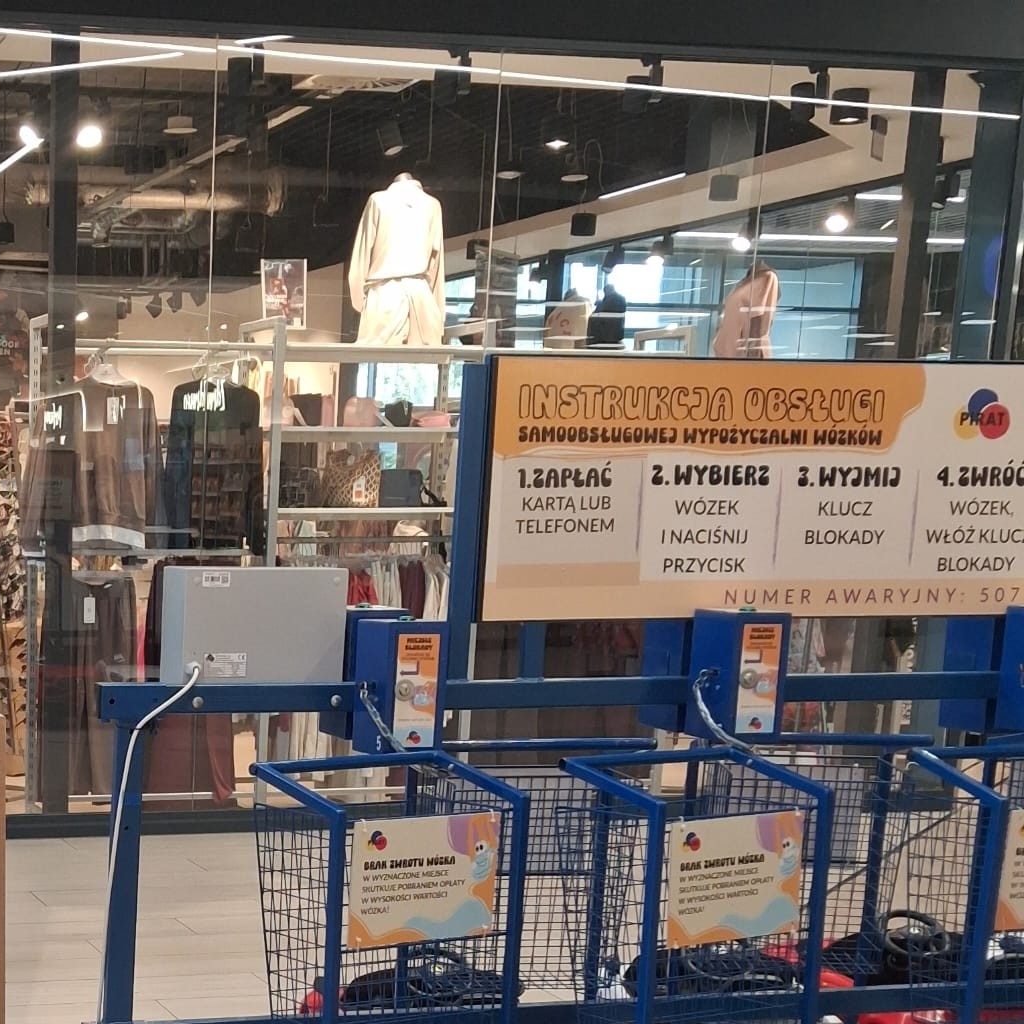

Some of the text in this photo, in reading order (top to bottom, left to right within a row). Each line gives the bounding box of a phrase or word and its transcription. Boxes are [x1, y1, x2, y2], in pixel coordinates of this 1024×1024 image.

[518, 384, 886, 423] INSTRUKCJA OBSŁUGI
[959, 412, 1006, 427] PIRAT
[518, 423, 883, 446] SAMOOBSŁUGOWEJ WYPOŻYCZALNI WÓZKÓW
[674, 464, 770, 487] WYBIERZ
[819, 466, 902, 488] WYJMIJ
[937, 466, 954, 487] 4.
[522, 495, 611, 514] KARTĄ LUB
[675, 497, 739, 516] WÓZEK
[818, 501, 873, 517] KLUCZ
[516, 518, 615, 534] TELEFONEM
[661, 526, 749, 545] I NACIŚNIJ
[926, 526, 975, 545] WŁÓŻ
[804, 529, 885, 545] BLOKADY
[663, 557, 745, 573] PRZYCISK
[936, 556, 1016, 572] BLOKADY
[724, 586, 1020, 605] NUMER AWARYJNY: 507
